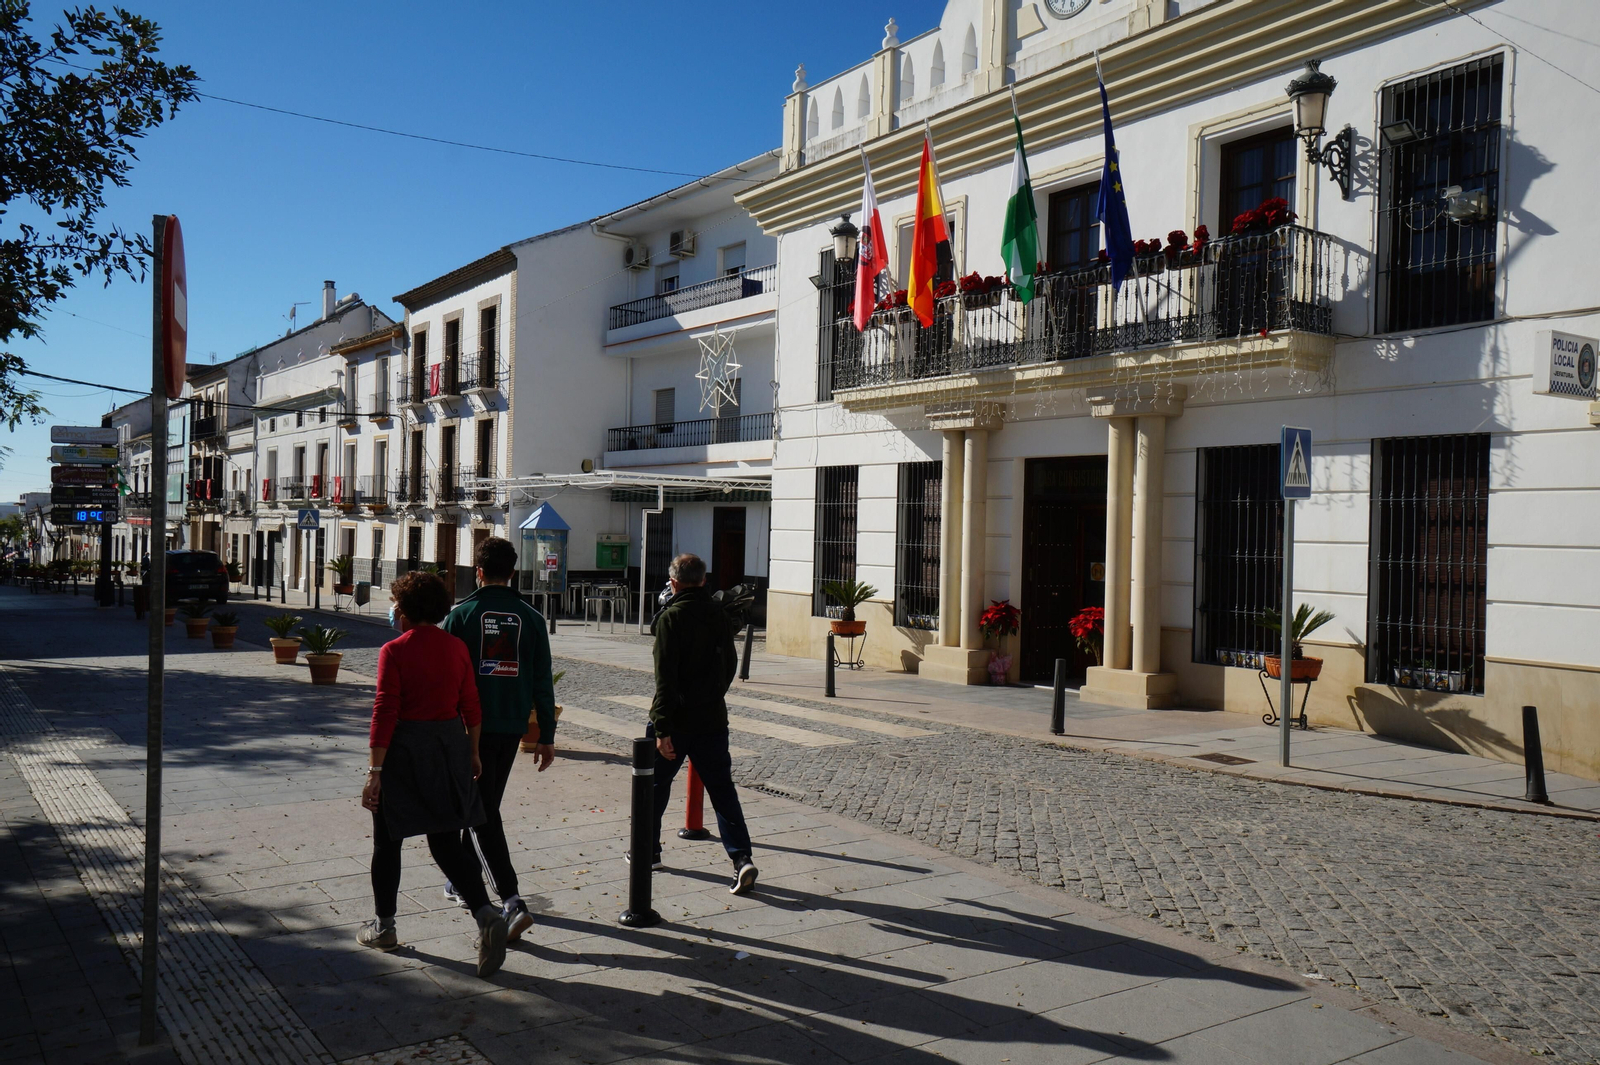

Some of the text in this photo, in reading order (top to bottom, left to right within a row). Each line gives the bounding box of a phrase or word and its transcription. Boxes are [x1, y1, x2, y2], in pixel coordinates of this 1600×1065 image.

[1552, 338, 1578, 354] POLICIA
[1554, 353, 1575, 368] LOCAL
[1058, 469, 1105, 487] CONSISTORI
[77, 511, 87, 521] 18
